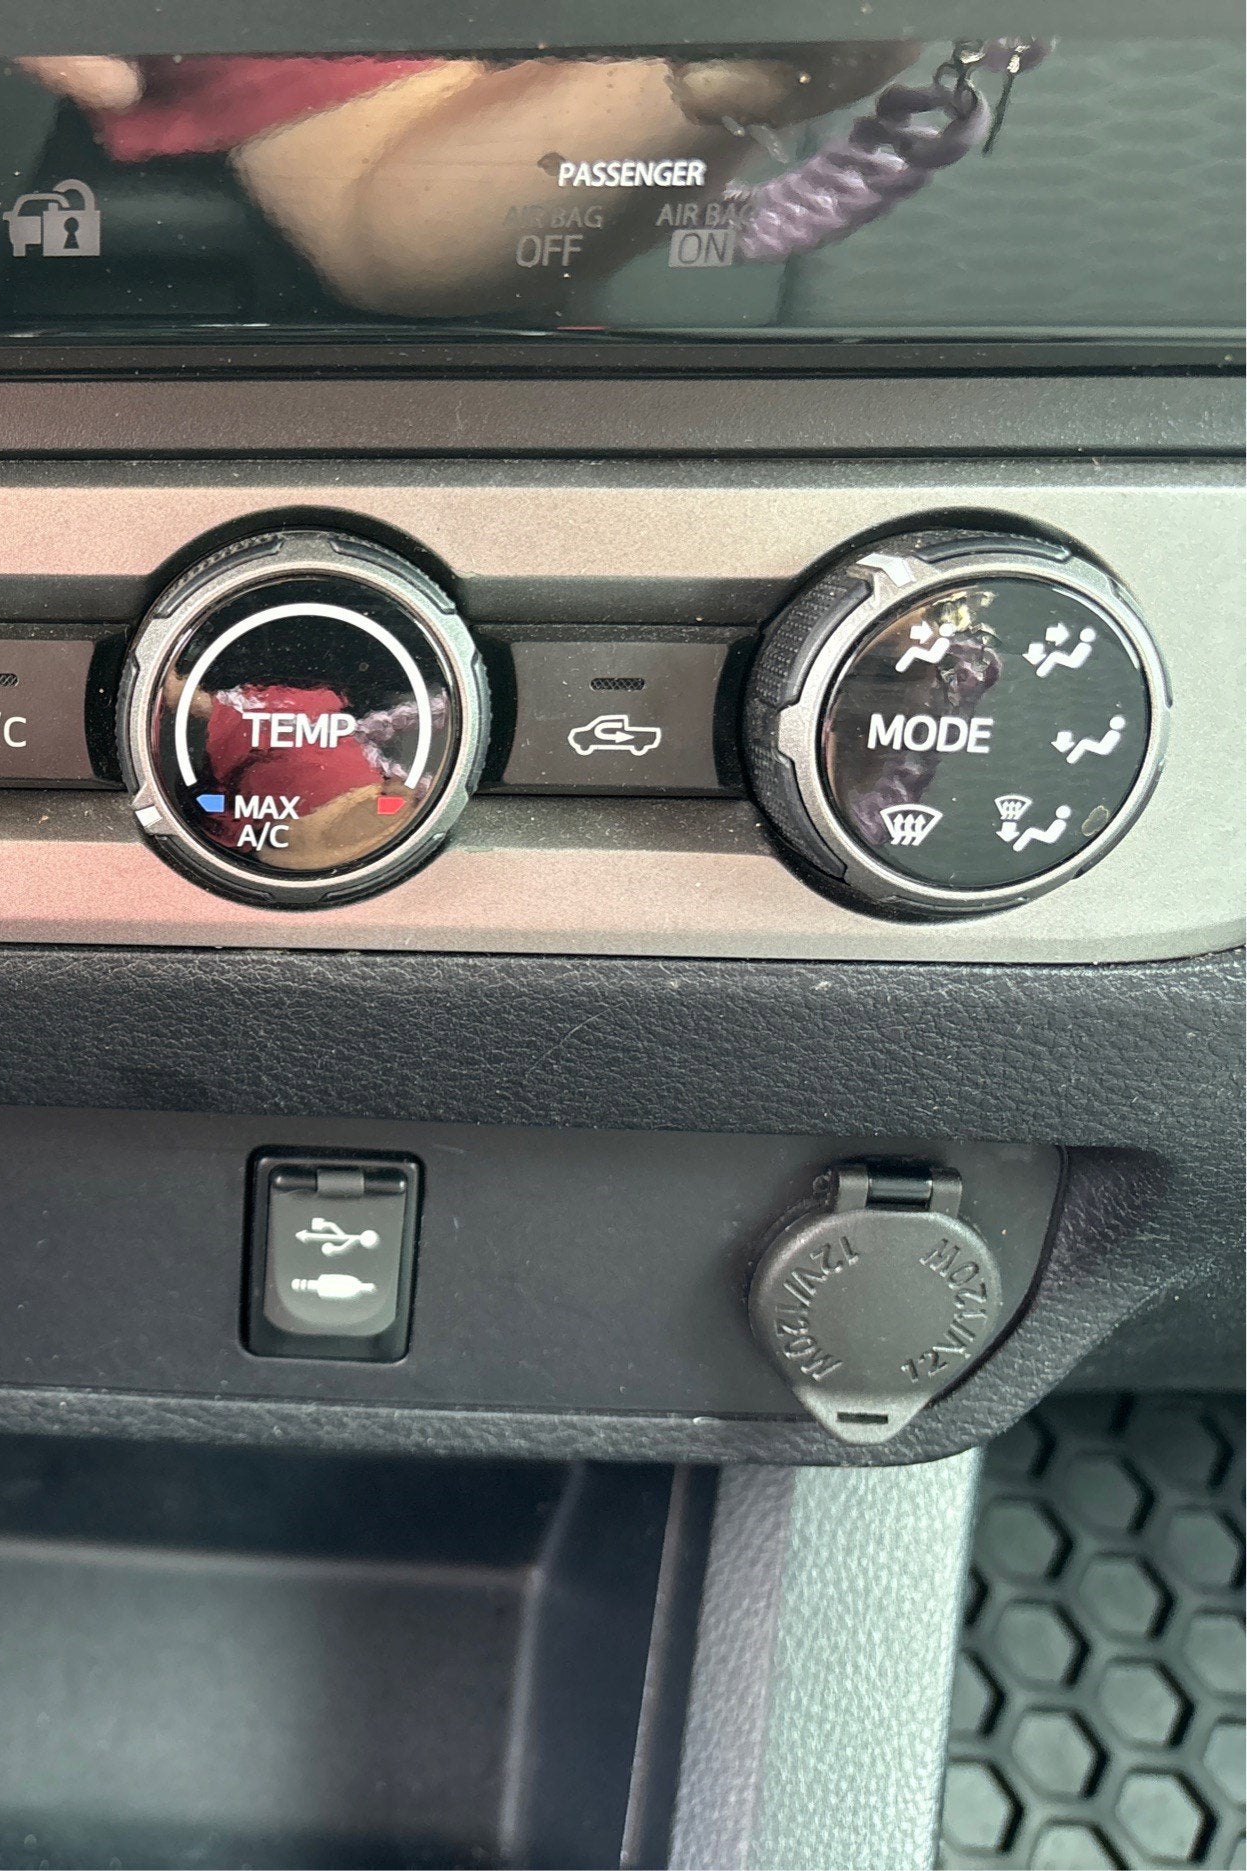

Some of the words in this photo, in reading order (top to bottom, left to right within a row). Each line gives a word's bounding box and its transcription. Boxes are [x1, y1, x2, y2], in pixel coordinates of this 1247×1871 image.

[556, 158, 706, 187] PASSENGER
[504, 203, 544, 229] AIR
[550, 204, 603, 228] BAG
[655, 203, 698, 227] AIR
[515, 233, 584, 268] OFF
[677, 232, 730, 265] ON
[242, 713, 357, 748] TEMP
[867, 713, 994, 754] MODE
[233, 796, 301, 819] MAX
[236, 822, 290, 851] A/C
